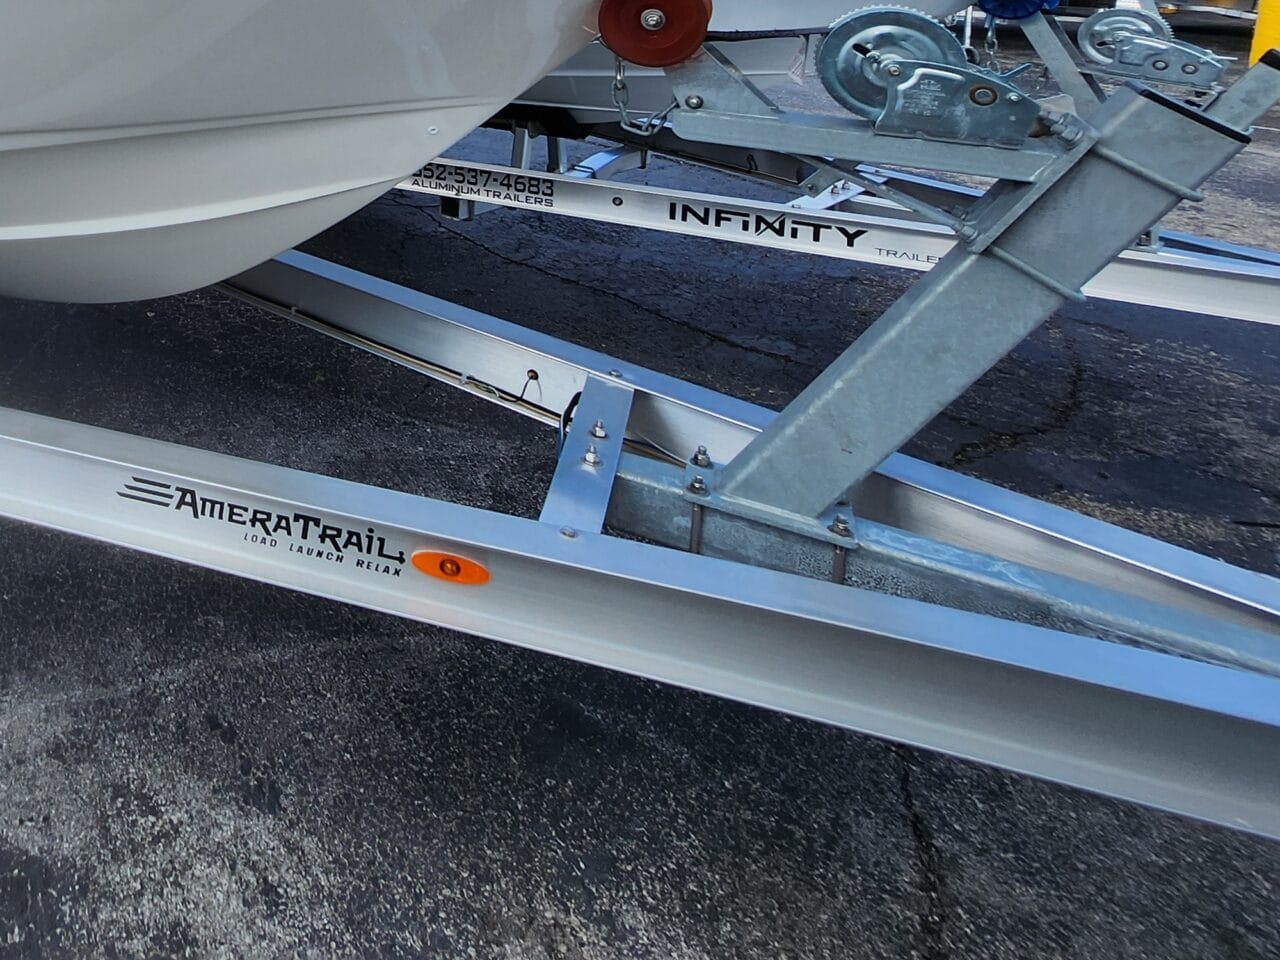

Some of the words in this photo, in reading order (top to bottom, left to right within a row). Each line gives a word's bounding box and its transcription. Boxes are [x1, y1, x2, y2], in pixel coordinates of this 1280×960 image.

[411, 178, 481, 196] ALUMINUM
[483, 189, 554, 208] TRAILERS
[874, 247, 943, 265] TRAILE
[243, 532, 278, 548] LOAD
[288, 542, 345, 564] LAUNCH
[355, 557, 402, 578] RELAX
